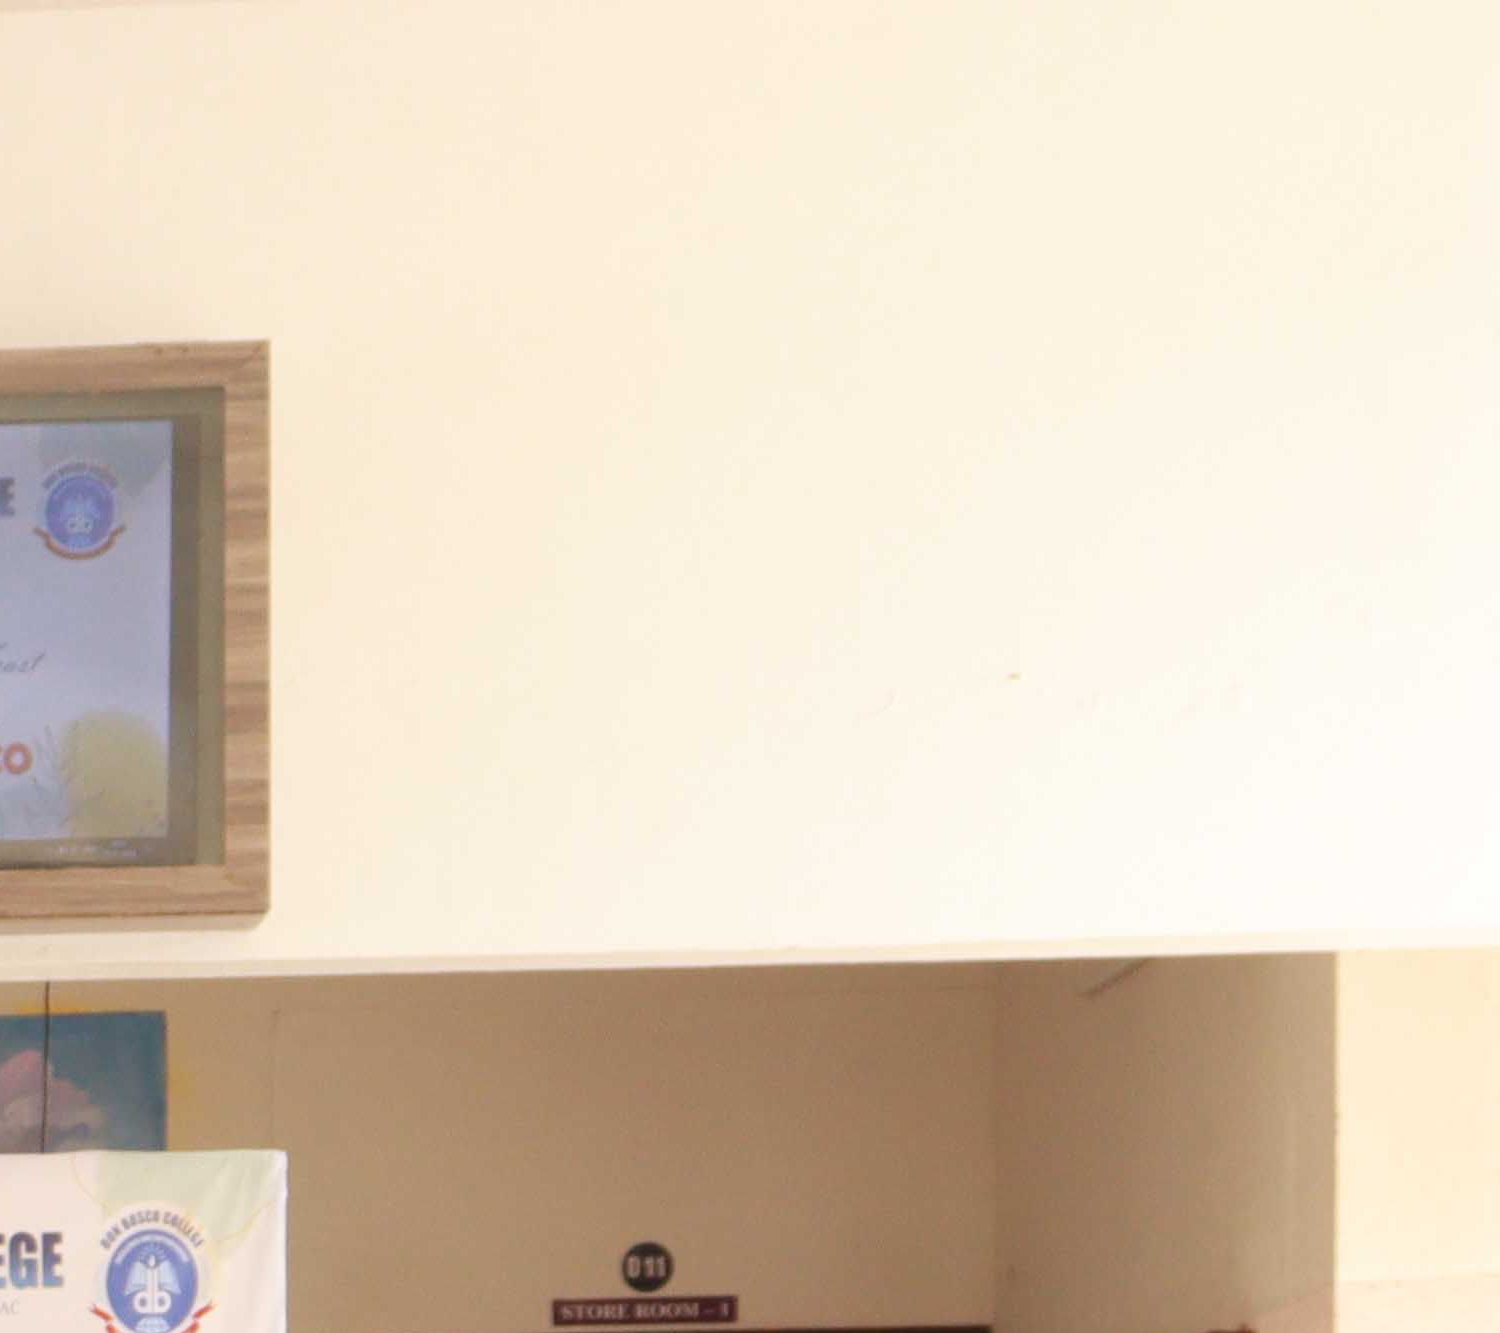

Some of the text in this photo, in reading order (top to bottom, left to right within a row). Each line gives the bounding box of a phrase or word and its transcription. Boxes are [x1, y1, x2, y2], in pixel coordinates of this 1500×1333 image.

[626, 1256, 667, 1278] 011
[560, 1304, 629, 1319] STORE
[634, 1303, 699, 1318] ROOM
